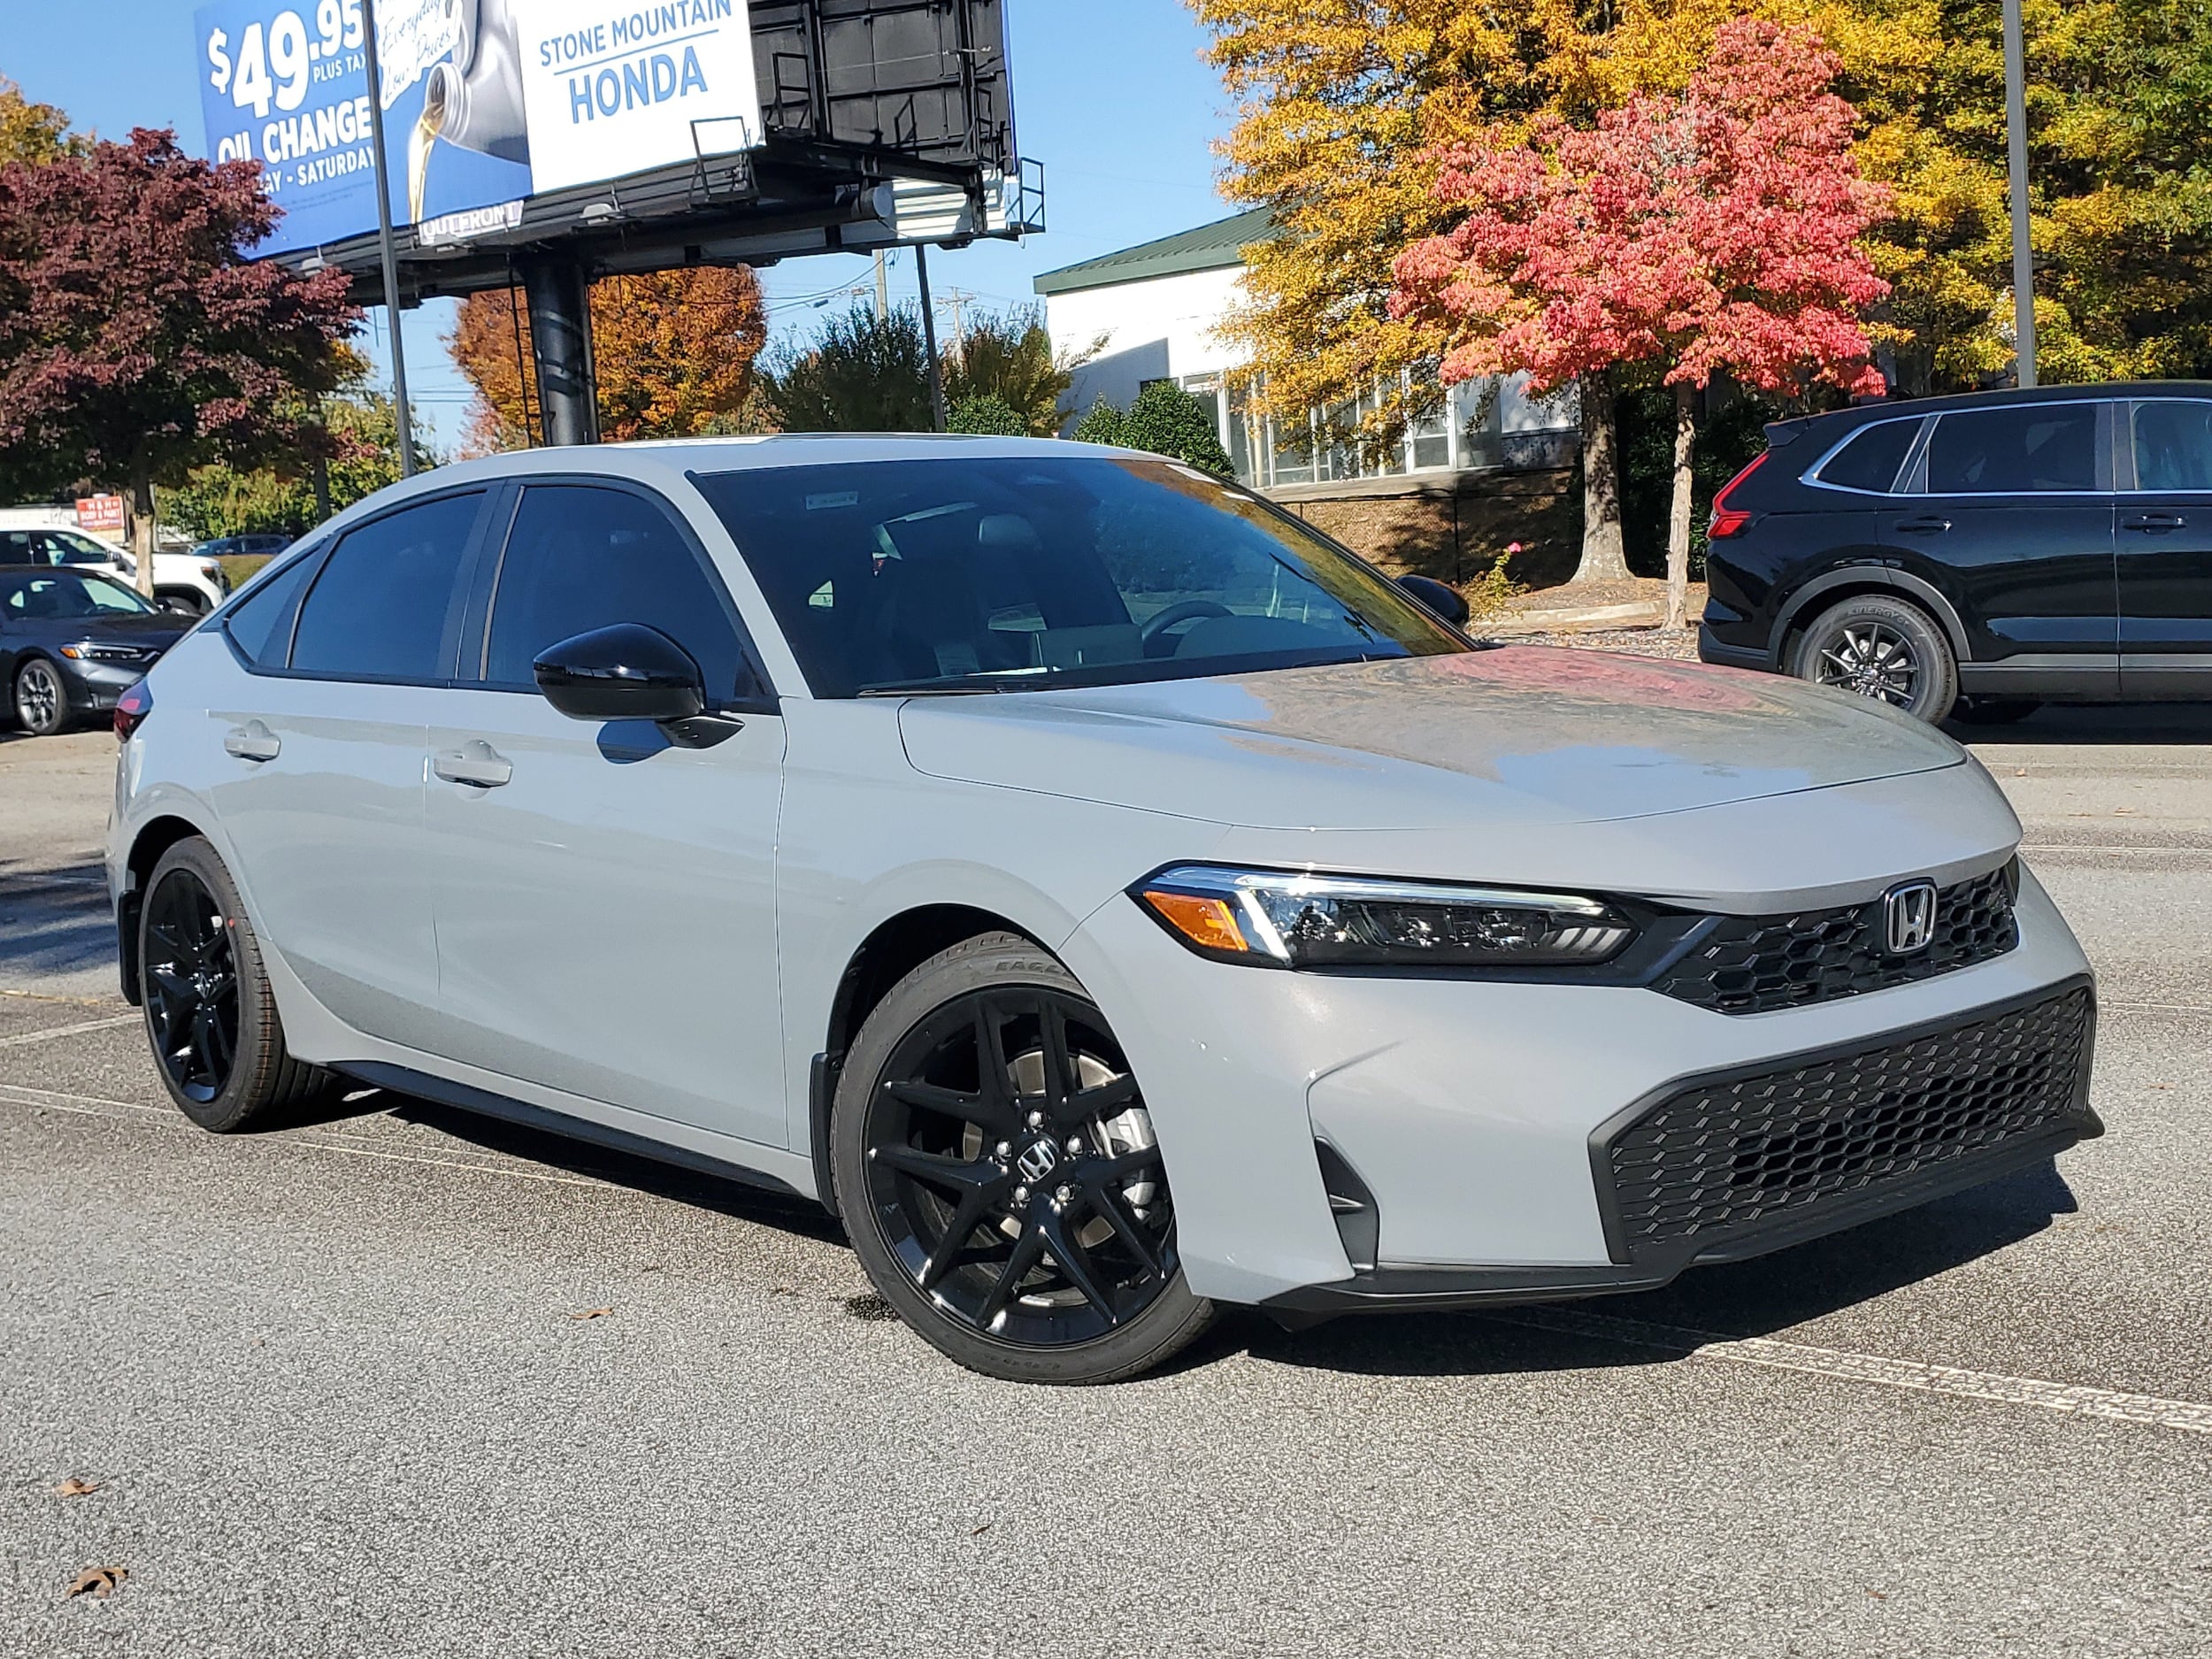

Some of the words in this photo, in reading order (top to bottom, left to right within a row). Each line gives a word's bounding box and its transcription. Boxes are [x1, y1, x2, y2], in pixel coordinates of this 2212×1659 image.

[207, 0, 365, 119] $49.95
[540, 24, 607, 67] STONE
[611, 0, 733, 48] MOUNTAIN
[313, 58, 343, 84] PLUS
[569, 45, 709, 125] HONDA
[262, 95, 374, 165] CHANGE
[296, 145, 375, 187] SATURDAY
[423, 204, 520, 237] OUTFRONT
